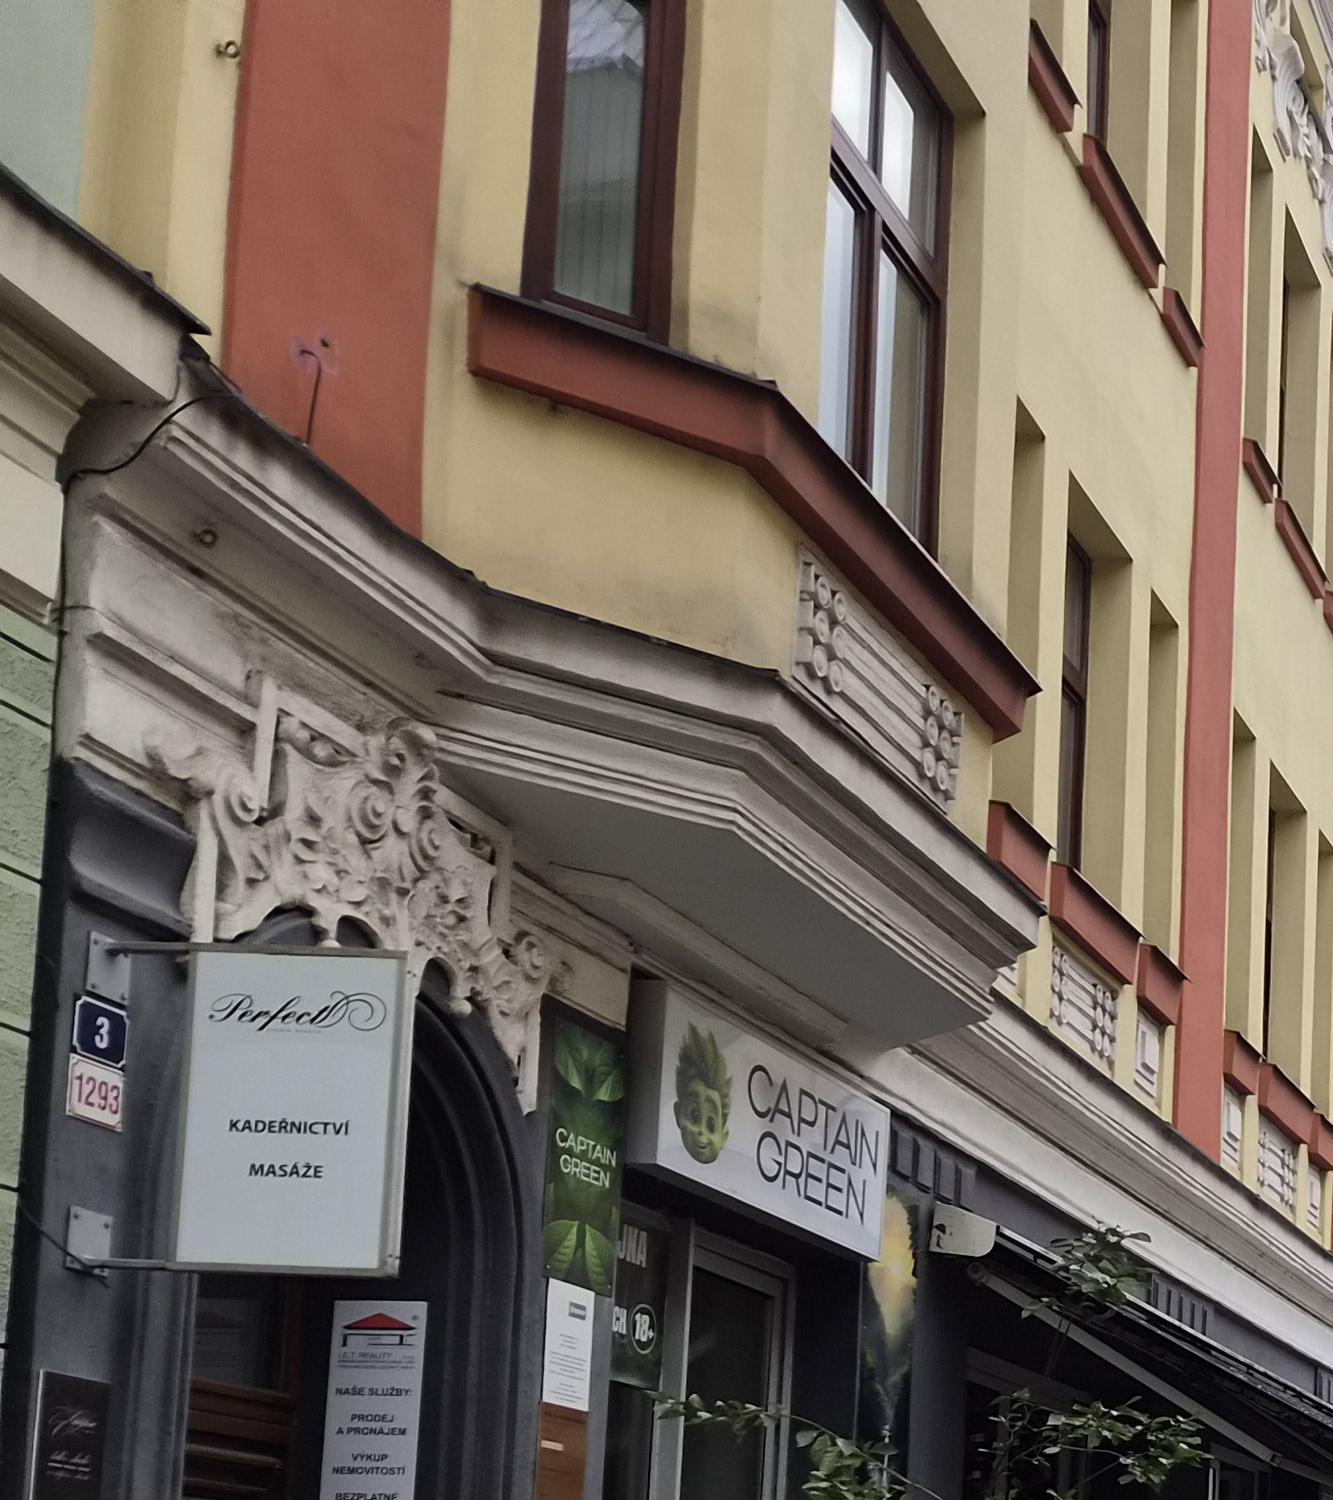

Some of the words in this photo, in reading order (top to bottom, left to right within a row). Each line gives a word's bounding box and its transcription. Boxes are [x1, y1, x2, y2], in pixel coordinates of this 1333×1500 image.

[207, 990, 387, 1032] Perfect
[94, 1016, 110, 1049] 3
[74, 1072, 121, 1115] 1293
[228, 1118, 351, 1136] KADEŘNICTVÍ
[746, 1063, 880, 1178] CAPTAIN
[555, 1127, 617, 1168] CAPTAIN
[248, 1162, 325, 1179] MASÁŽE
[559, 1154, 610, 1189] GREEN
[755, 1129, 867, 1226] GREEN
[634, 1312, 655, 1342] 18+
[335, 1385, 365, 1397] NAŠE
[335, 1426, 345, 1435] A
[346, 1425, 407, 1436] PRONÁJEM
[350, 1413, 395, 1423] PRODEJ
[331, 1464, 406, 1476] NEMOVITOSTÍ
[351, 1451, 388, 1462] VÝKUP
